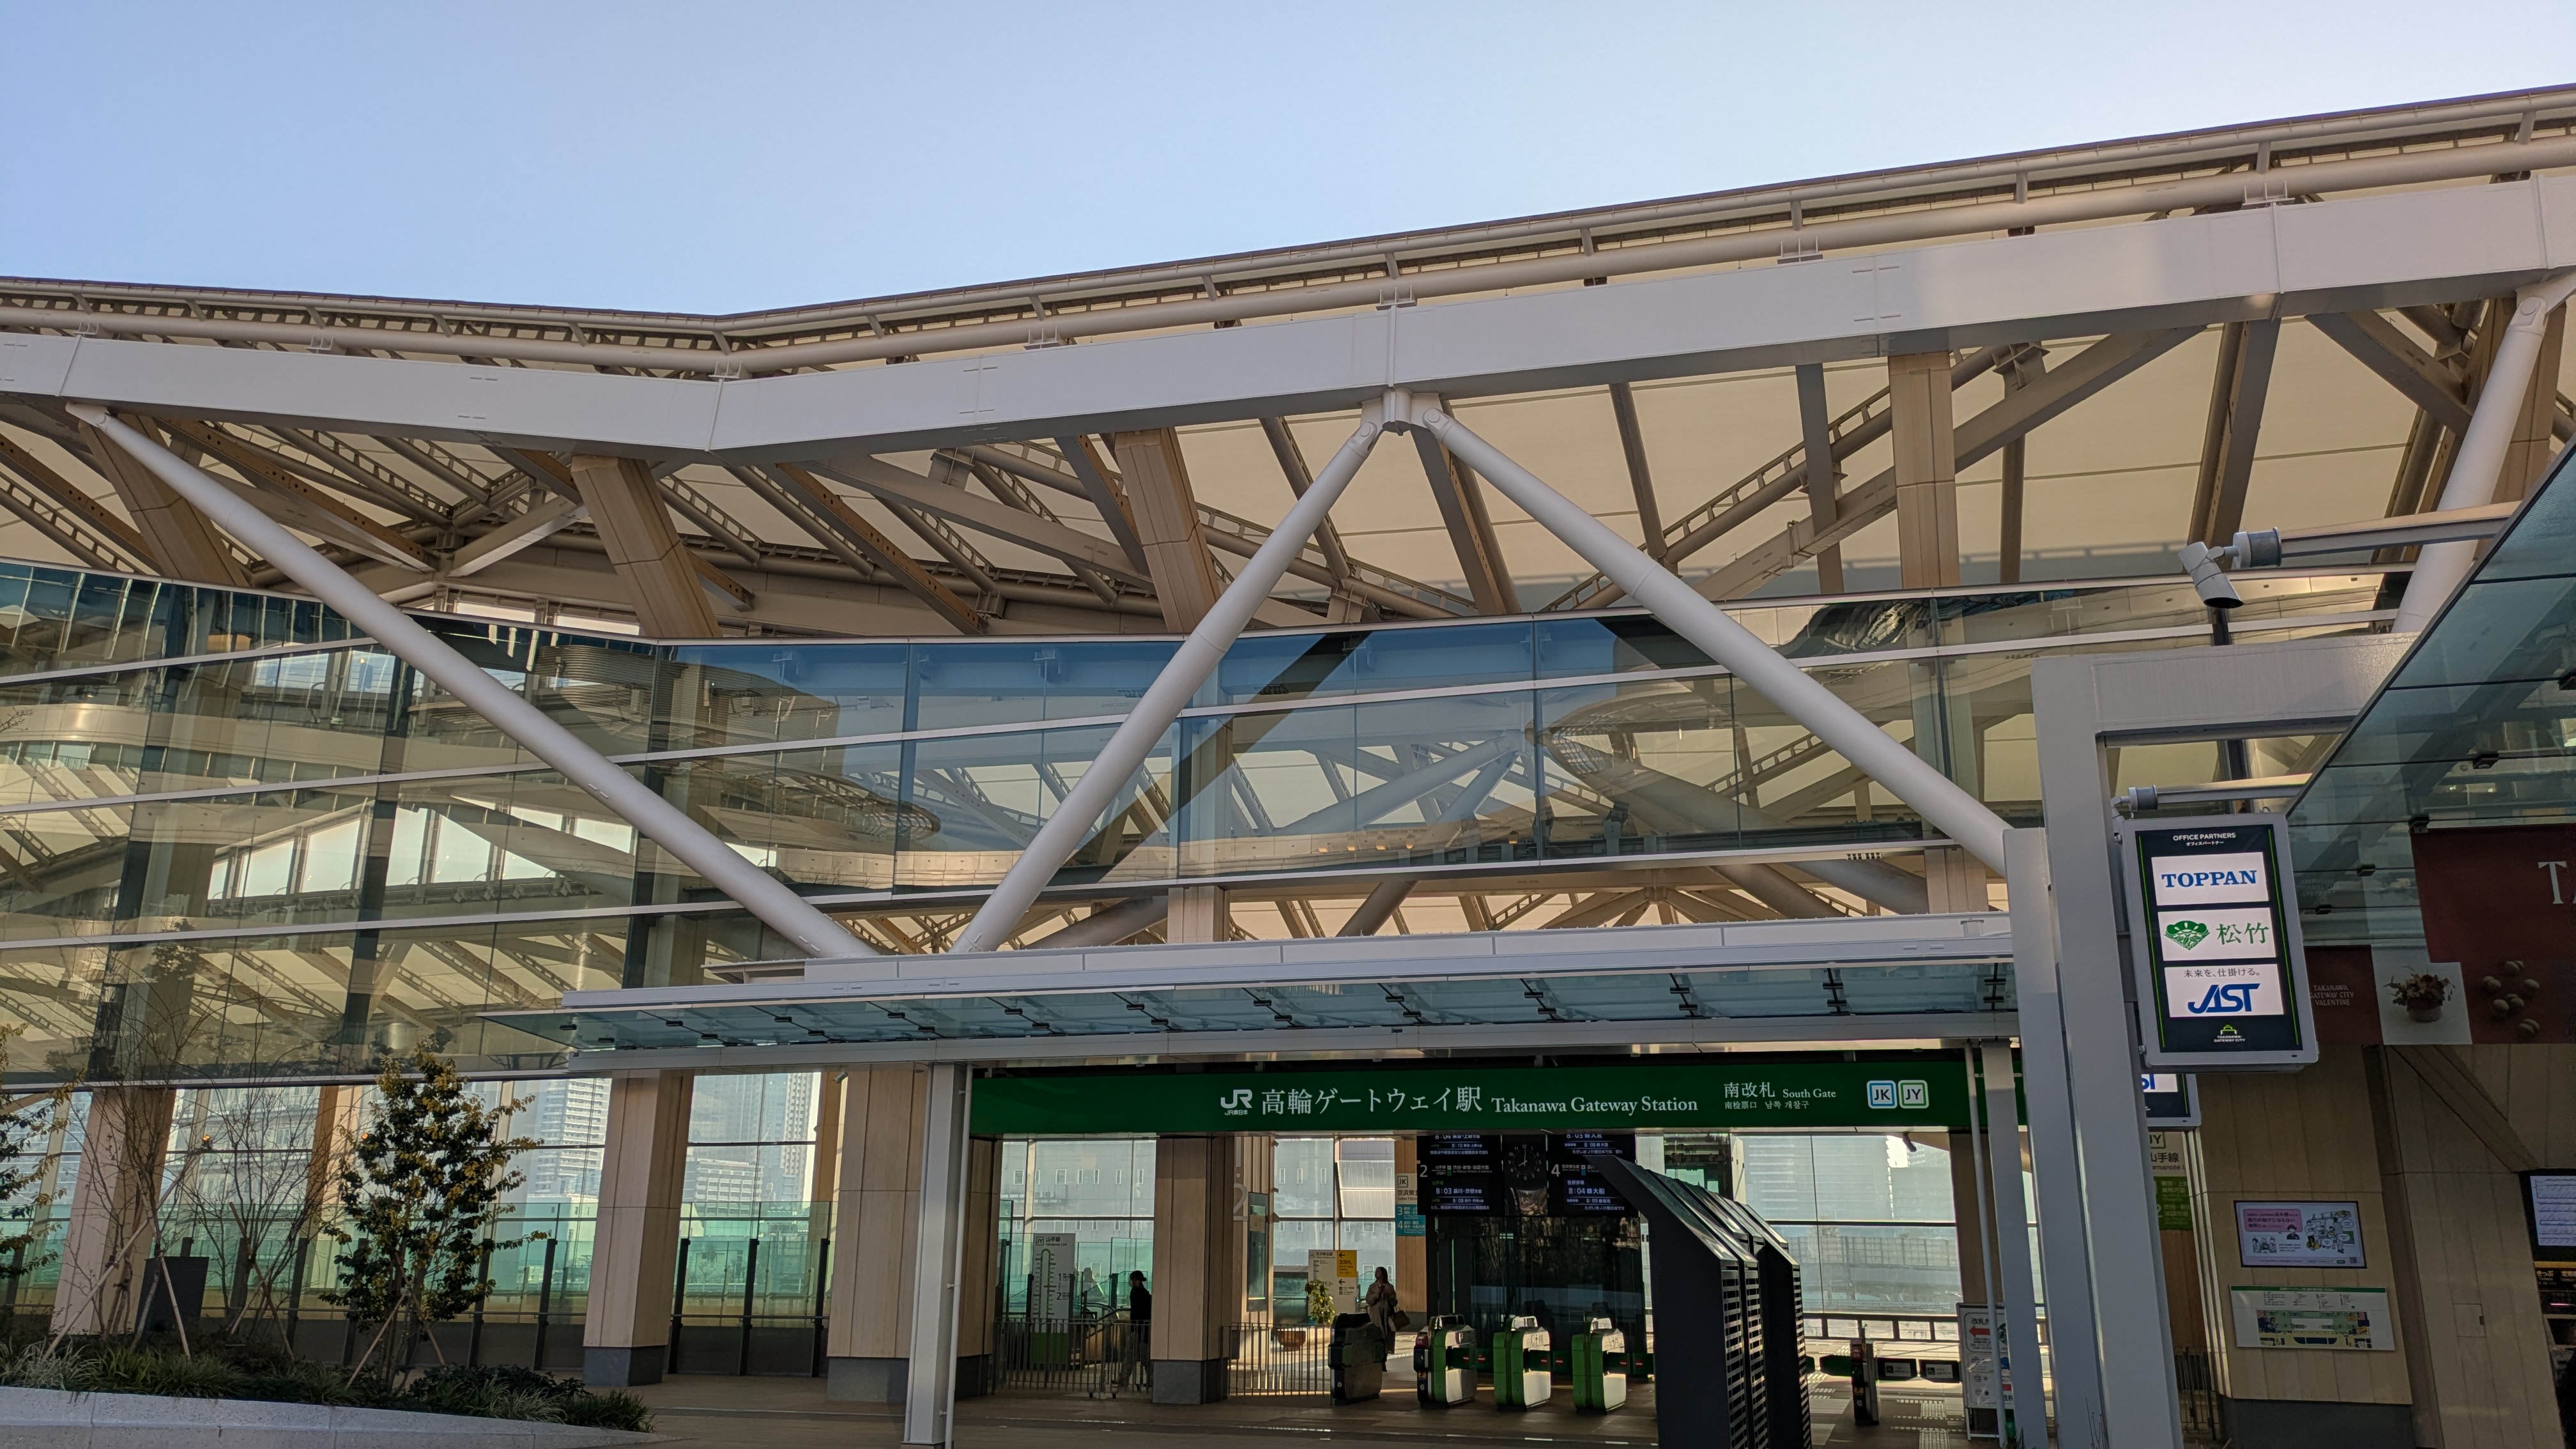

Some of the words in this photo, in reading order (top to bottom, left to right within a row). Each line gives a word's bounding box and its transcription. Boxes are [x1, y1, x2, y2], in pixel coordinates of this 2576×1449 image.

[2161, 870, 2257, 888] TOPPAN
[2538, 861, 2576, 904] T
[2215, 922, 2269, 946] 松竹
[2183, 967, 2260, 978] 未来を、仕掛ける。
[1724, 1082, 1775, 1098] 南改札
[1782, 1088, 1811, 1098] South
[1813, 1088, 1837, 1098] Gate
[1874, 1089, 1891, 1101] JK
[1905, 1088, 1922, 1100] JY
[1220, 1089, 1253, 1108] JR
[1261, 1086, 1483, 1115] 高輪ゲートウェイ駅
[1491, 1097, 1567, 1113] Takanawa
[1570, 1097, 1638, 1116] Gateway
[1641, 1096, 1698, 1112] Station
[1765, 1101, 1782, 1110] 남쪽
[1784, 1101, 1809, 1110] 개찰구
[1420, 1165, 1428, 1177] 2
[1551, 1163, 1561, 1177] 4
[1397, 1207, 1403, 1216] 3
[1397, 1221, 1404, 1230] 4
[1058, 1273, 1061, 1281] 1
[1056, 1292, 1062, 1300] 2
